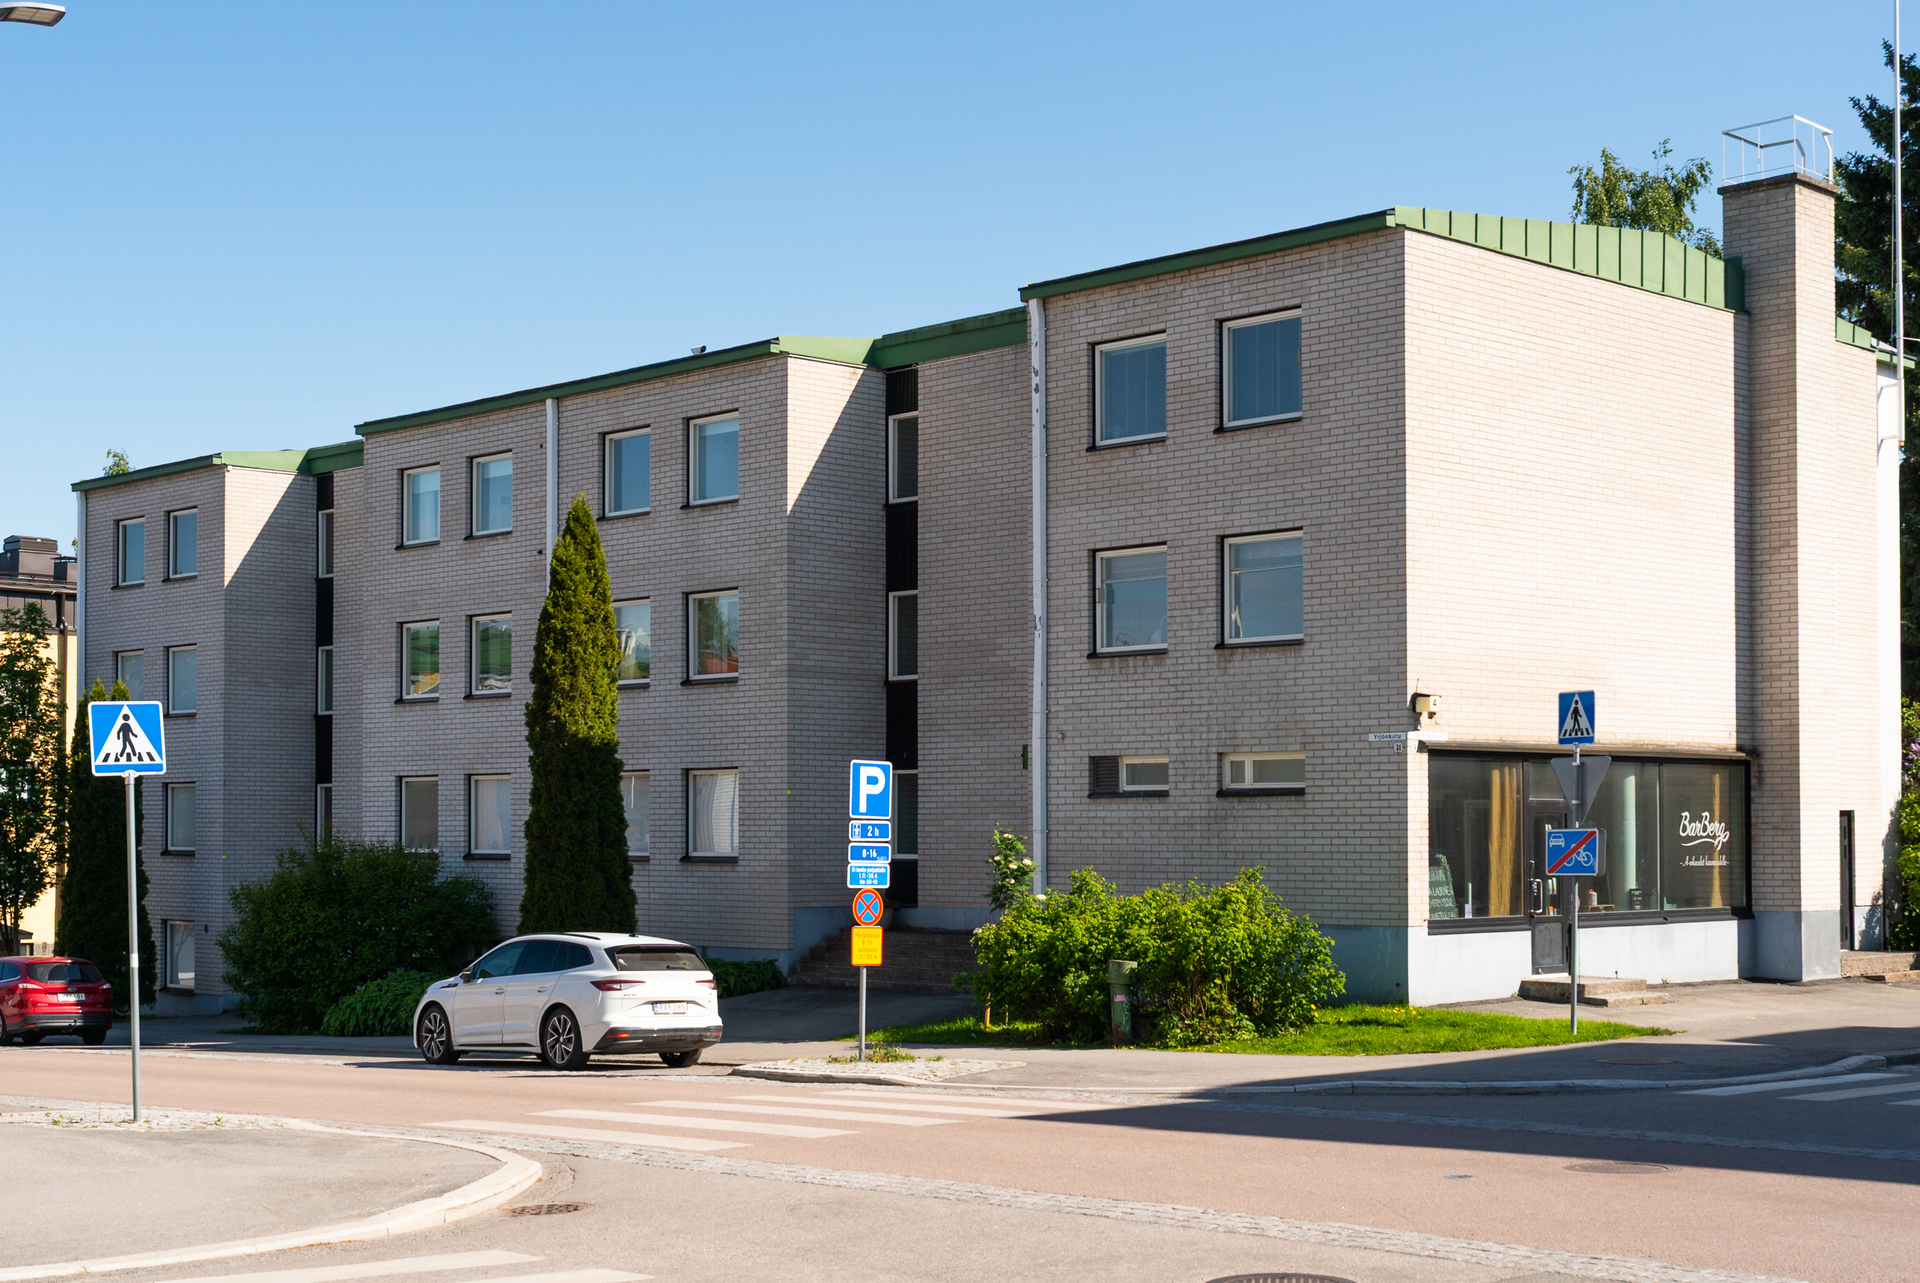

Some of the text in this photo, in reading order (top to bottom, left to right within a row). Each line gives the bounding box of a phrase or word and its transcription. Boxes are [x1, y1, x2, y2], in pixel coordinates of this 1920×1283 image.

[859, 766, 886, 813] P
[868, 826, 879, 836] 2 h
[1679, 811, 1730, 851] BarBerg
[862, 848, 877, 858] 8-16
